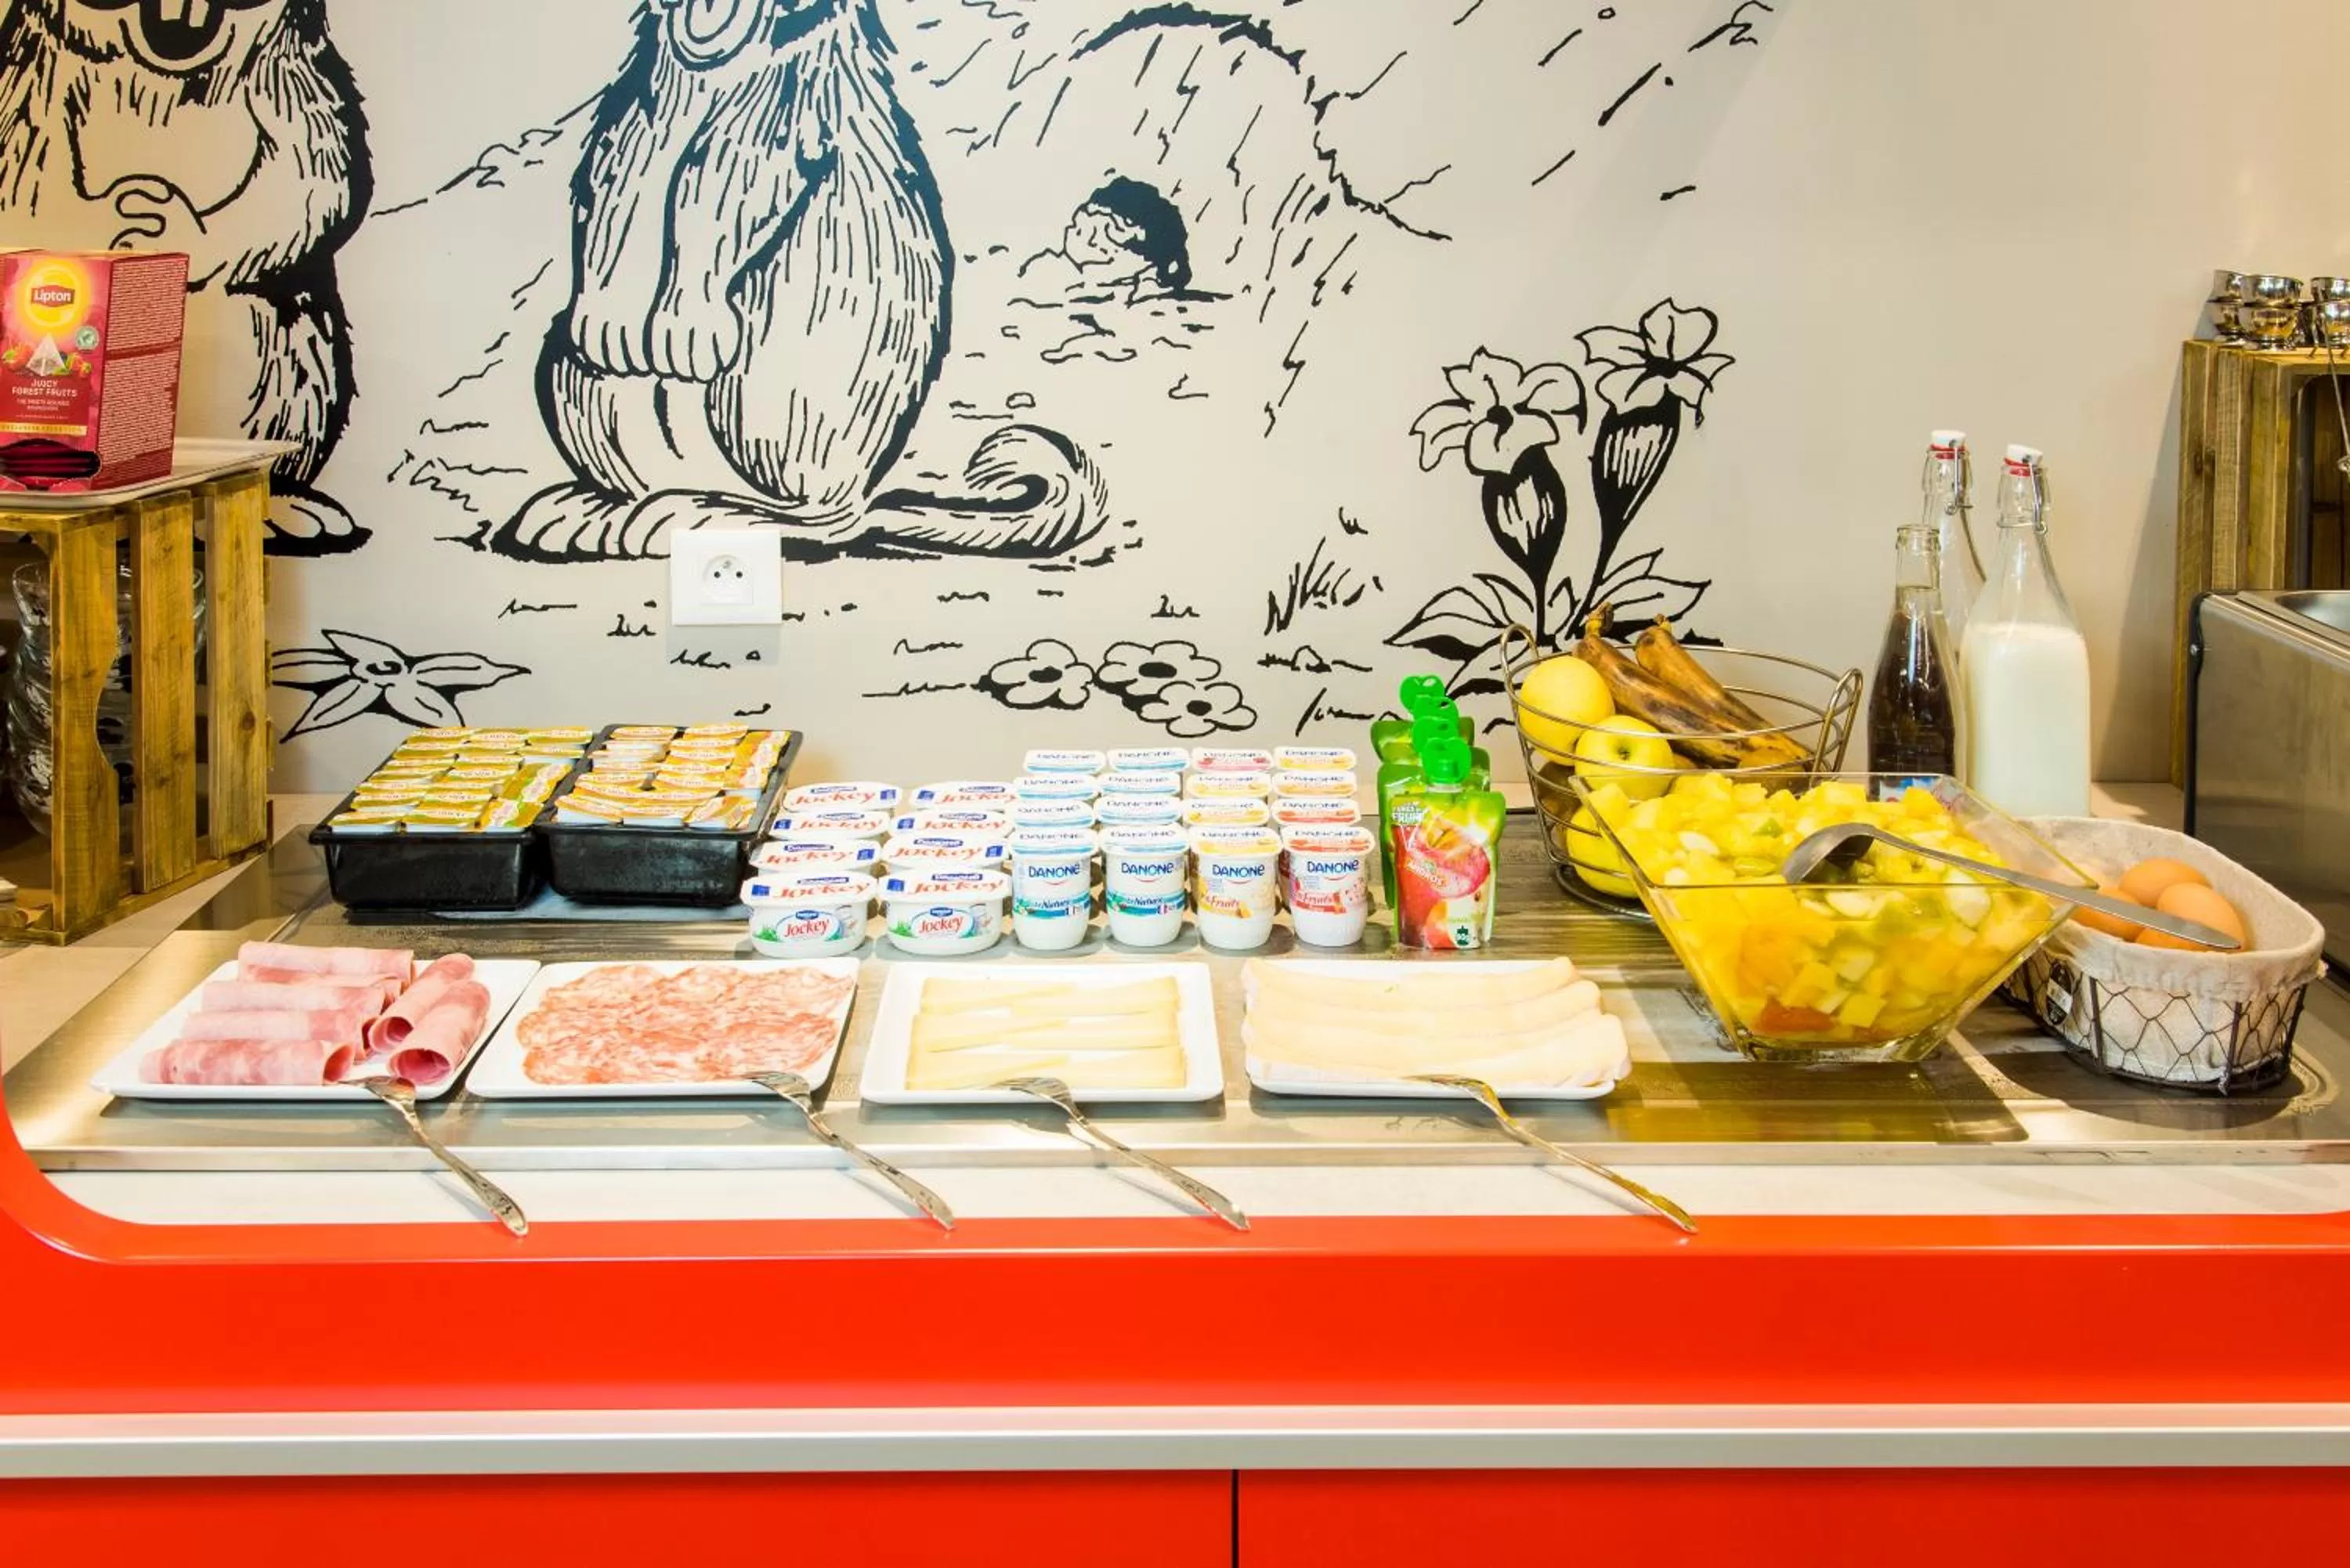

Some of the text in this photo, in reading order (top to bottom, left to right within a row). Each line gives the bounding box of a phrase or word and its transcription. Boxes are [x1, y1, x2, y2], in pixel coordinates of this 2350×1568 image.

[34, 288, 71, 303] Lipton
[784, 919, 829, 937] Jockey
[919, 916, 964, 934] Jockey
